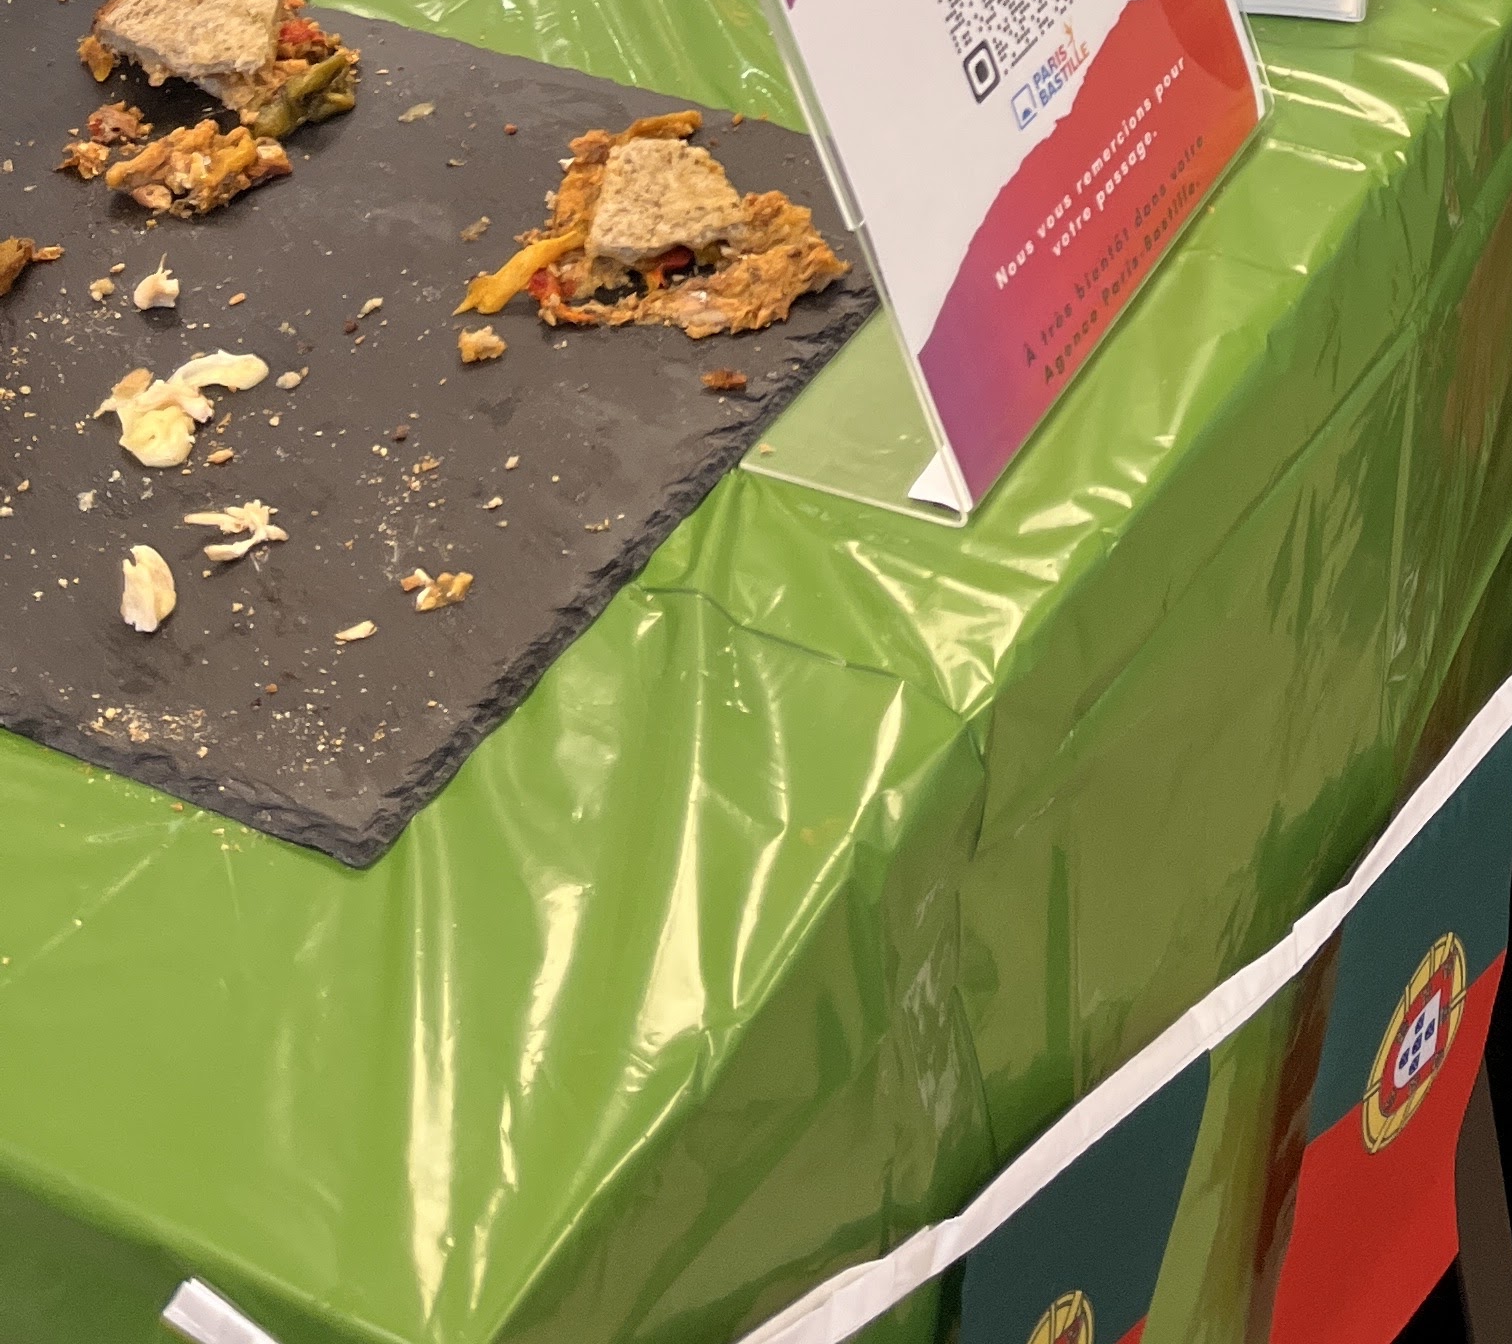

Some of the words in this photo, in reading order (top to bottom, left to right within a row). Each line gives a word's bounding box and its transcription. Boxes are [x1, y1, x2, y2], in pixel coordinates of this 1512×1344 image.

[1032, 44, 1068, 91] PARIS
[1039, 41, 1091, 107] BASTILLE
[994, 239, 1034, 290] Nous
[1036, 194, 1073, 239] vous
[1075, 97, 1153, 195] remercions
[1154, 55, 1186, 104] pour
[1052, 206, 1092, 257] votre
[1095, 130, 1159, 212] passage.
